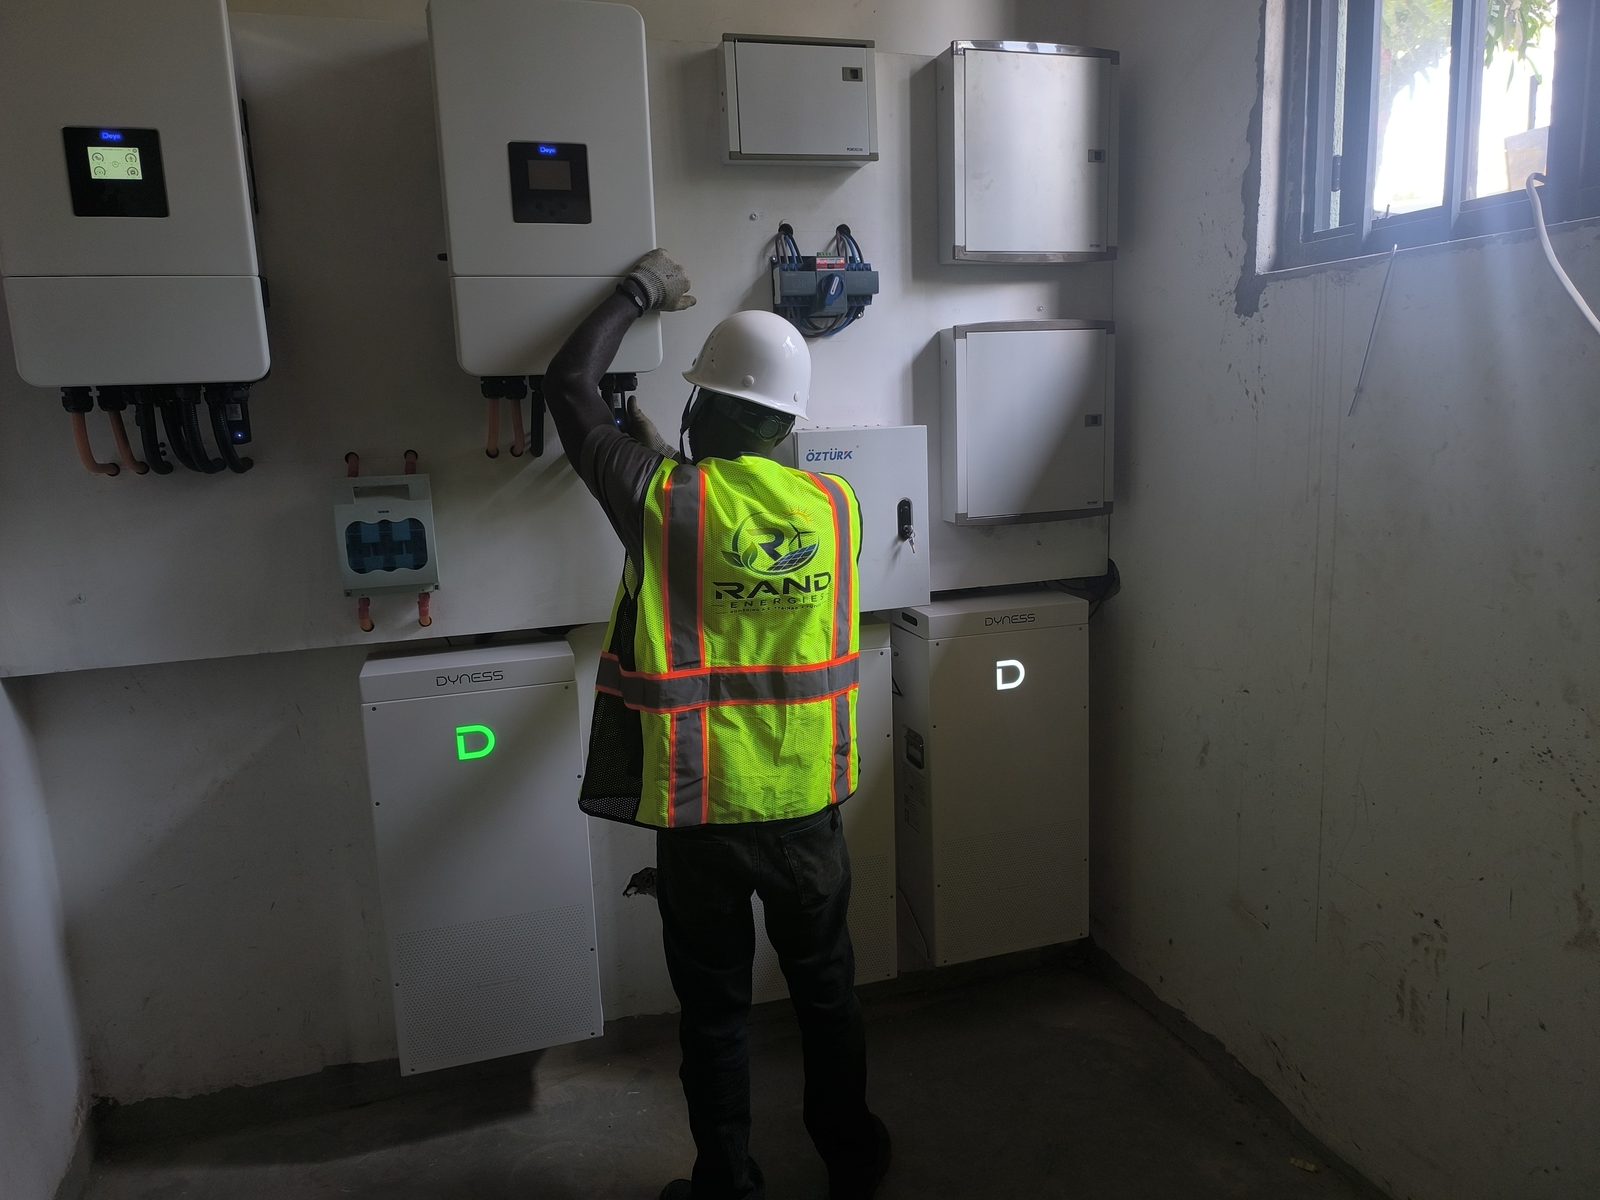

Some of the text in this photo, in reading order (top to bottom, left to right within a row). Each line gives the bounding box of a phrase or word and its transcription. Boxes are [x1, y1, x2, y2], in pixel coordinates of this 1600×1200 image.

[806, 447, 853, 462] ÖZTÜRK
[713, 571, 832, 600] RAND
[984, 613, 1036, 627] DYNESS
[436, 670, 504, 687] DYNESS
